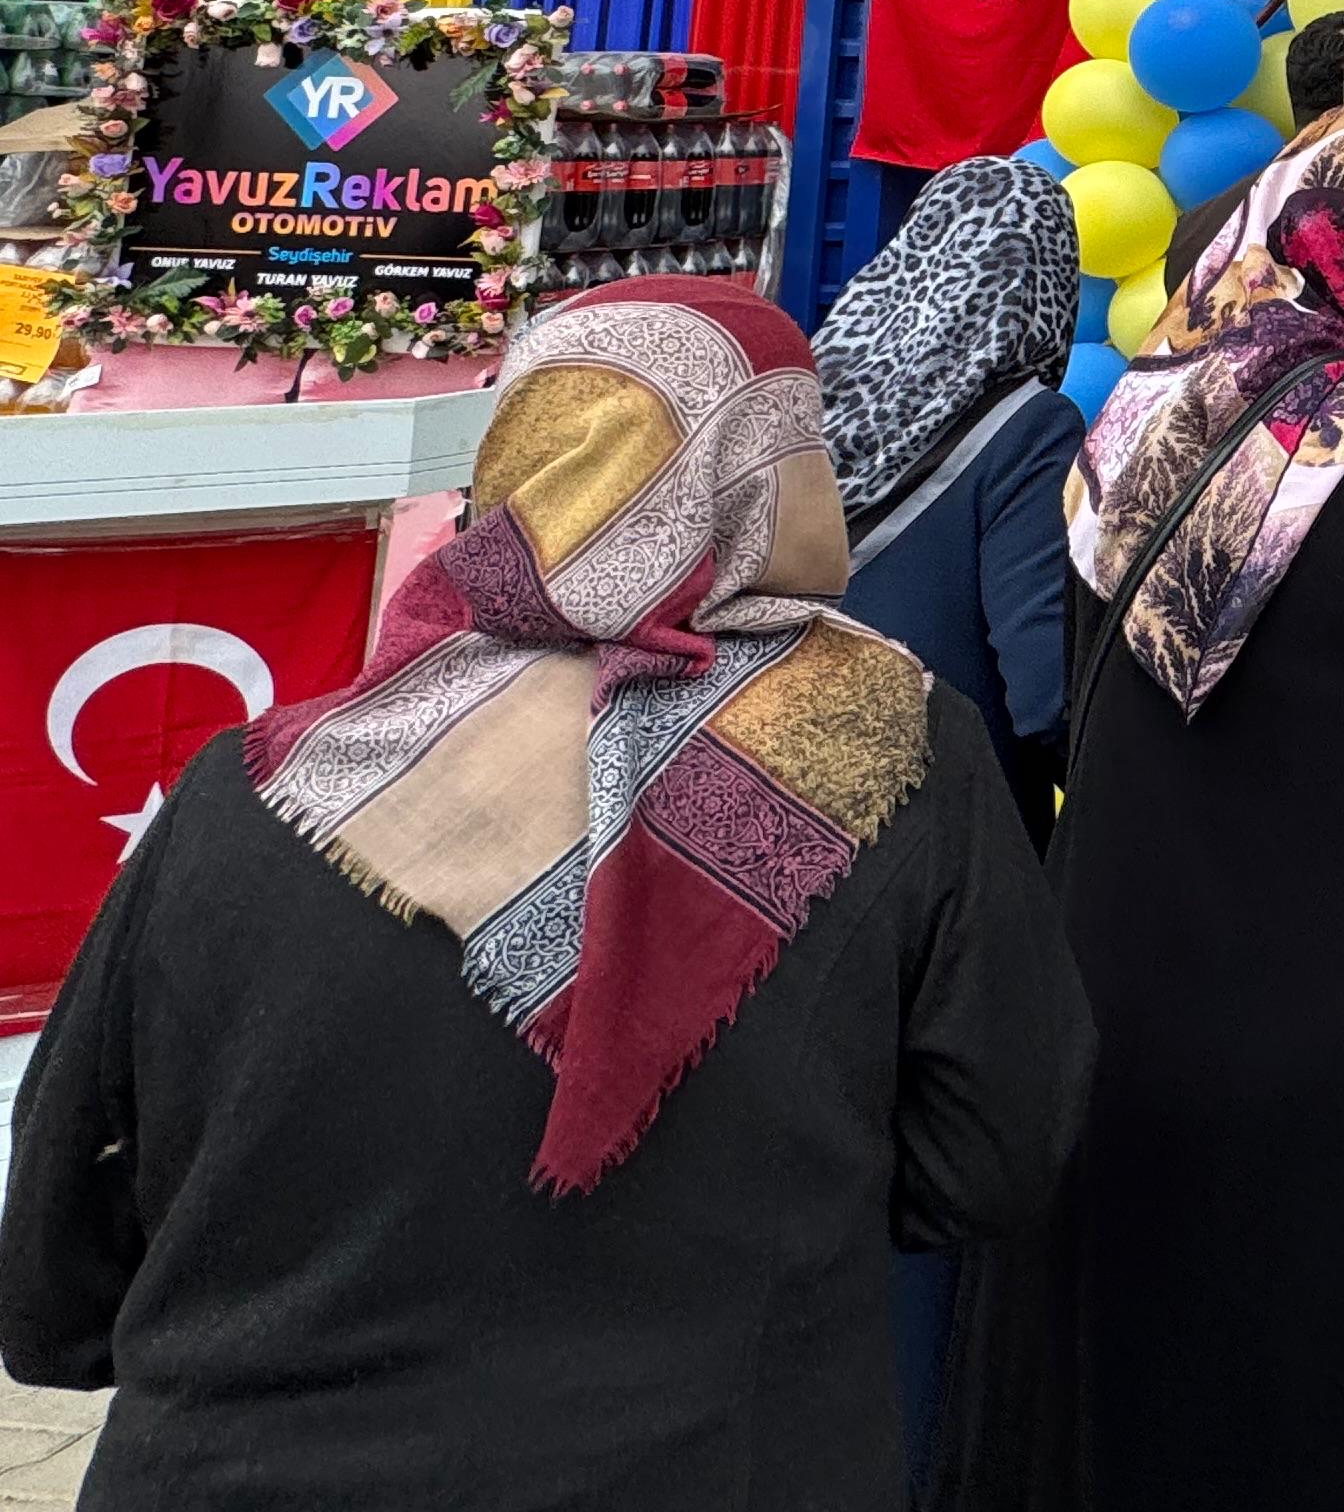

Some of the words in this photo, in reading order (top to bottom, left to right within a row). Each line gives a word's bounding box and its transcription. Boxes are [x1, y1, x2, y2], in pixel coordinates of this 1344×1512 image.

[301, 75, 367, 119] YR
[193, 258, 237, 270] YAVUZ
[256, 272, 308, 286] TURAN
[310, 274, 360, 288] YAVUZ
[432, 266, 474, 280] YAVUZ
